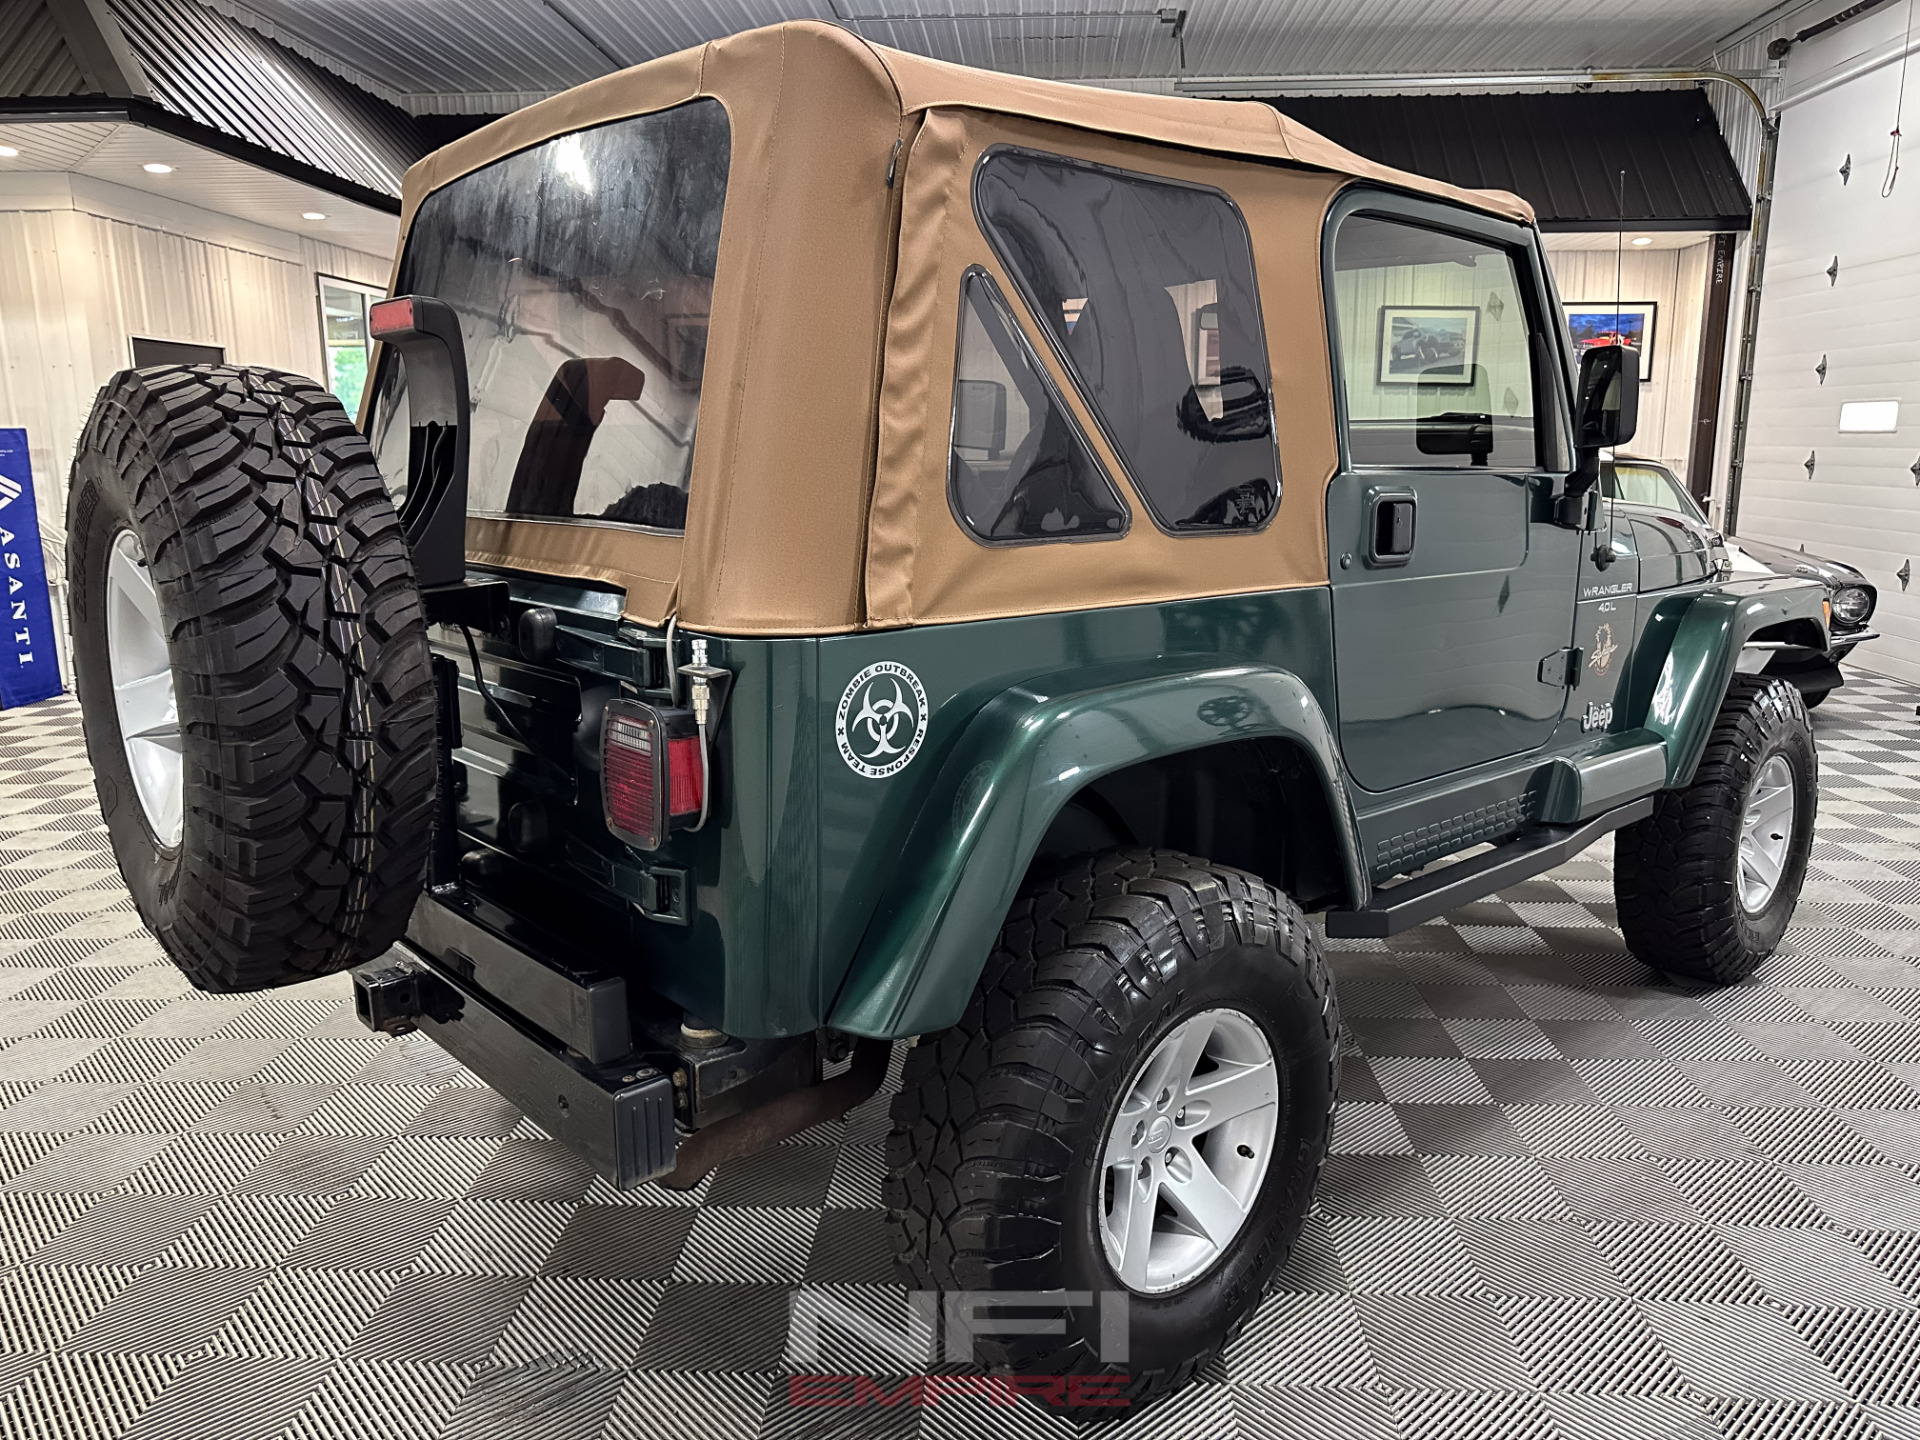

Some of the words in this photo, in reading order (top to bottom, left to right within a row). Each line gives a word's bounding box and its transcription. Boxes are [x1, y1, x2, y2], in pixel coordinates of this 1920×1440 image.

[1715, 249, 1726, 285] EMPIRE
[0, 526, 34, 665] ASANTI
[1583, 582, 1633, 598] WRANGLER
[838, 668, 872, 721] ZOMBIE
[874, 663, 927, 709] OUTBREAK
[1581, 701, 1614, 733] Jeep
[840, 741, 867, 774] TEAM
[869, 728, 925, 776] RESPONSE
